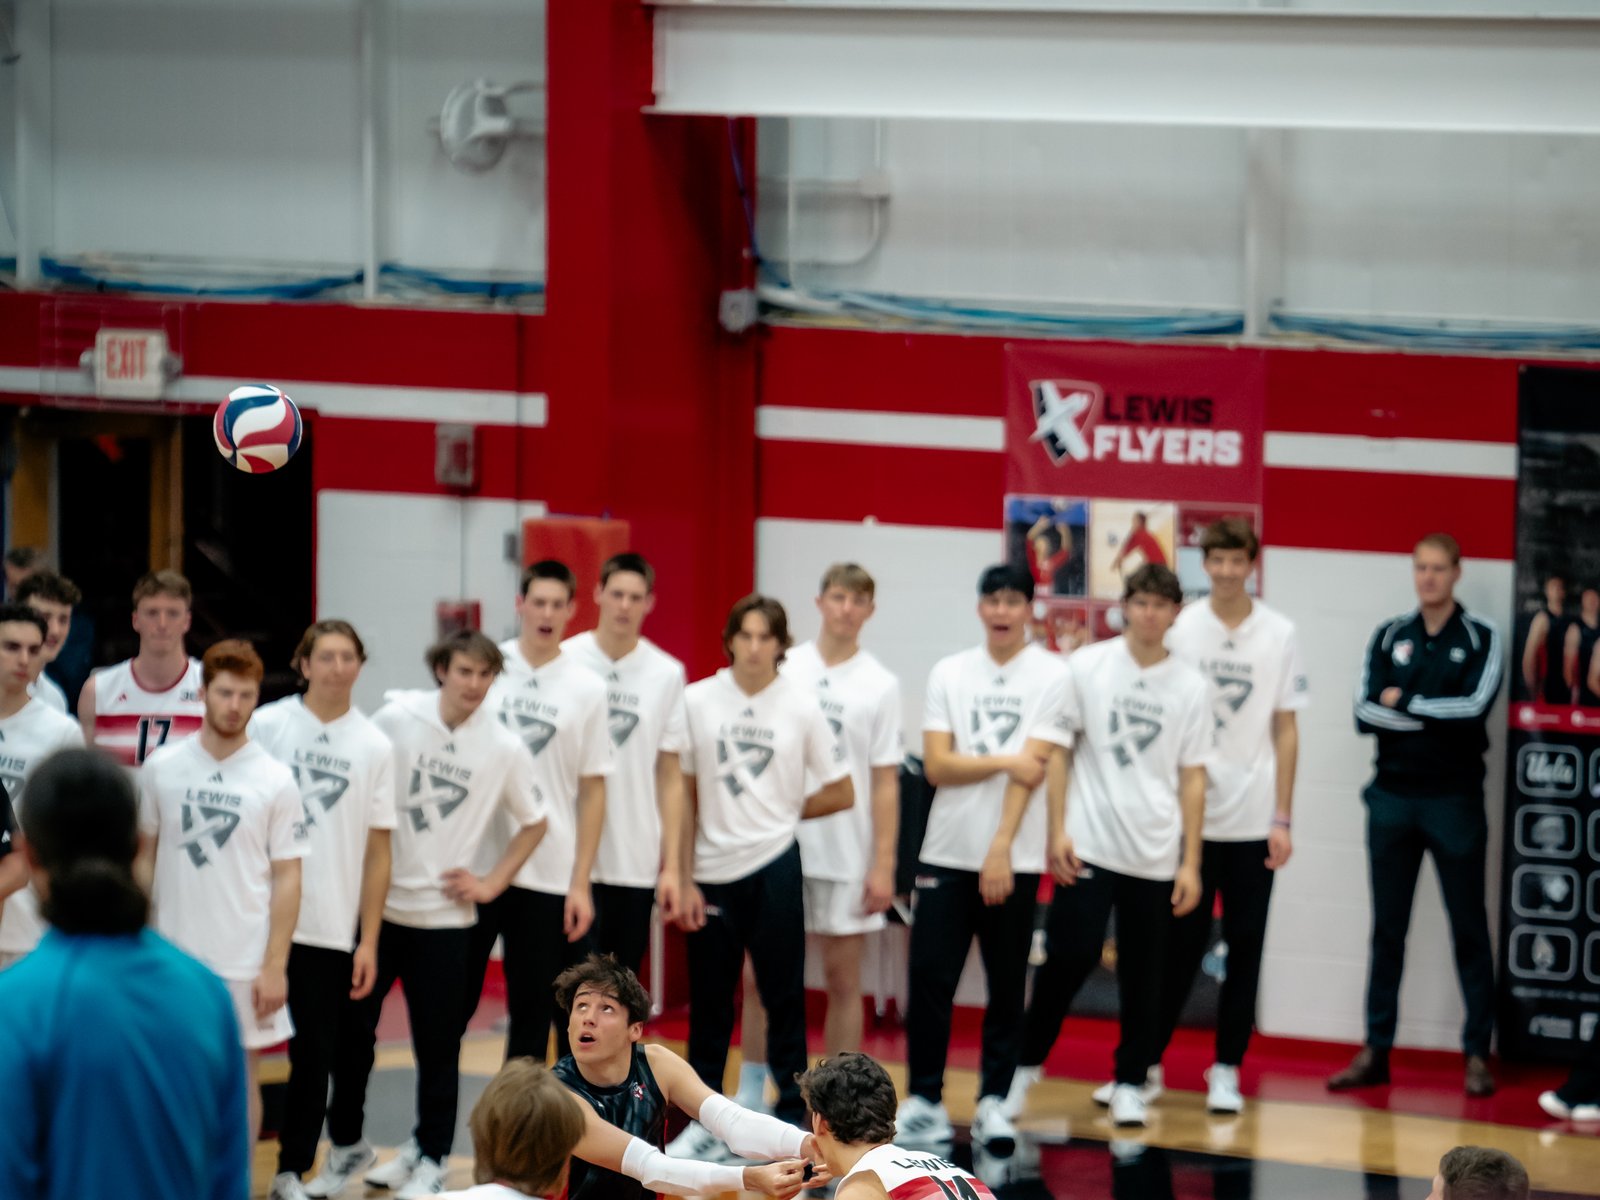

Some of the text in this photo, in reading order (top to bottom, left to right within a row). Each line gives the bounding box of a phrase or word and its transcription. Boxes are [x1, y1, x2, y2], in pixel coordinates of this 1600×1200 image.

[106, 338, 147, 380] EXIT
[1104, 395, 1213, 424] LEWIS
[1093, 425, 1243, 467] FLYERS
[501, 696, 559, 718] LEWIS
[607, 691, 639, 706] WIS
[1112, 696, 1164, 714] LEWIS
[135, 717, 172, 764] 17
[720, 723, 775, 740] LEWIS
[294, 749, 351, 771] LEWIS
[418, 753, 472, 781] LEWIS
[186, 788, 242, 807] LEWIS
